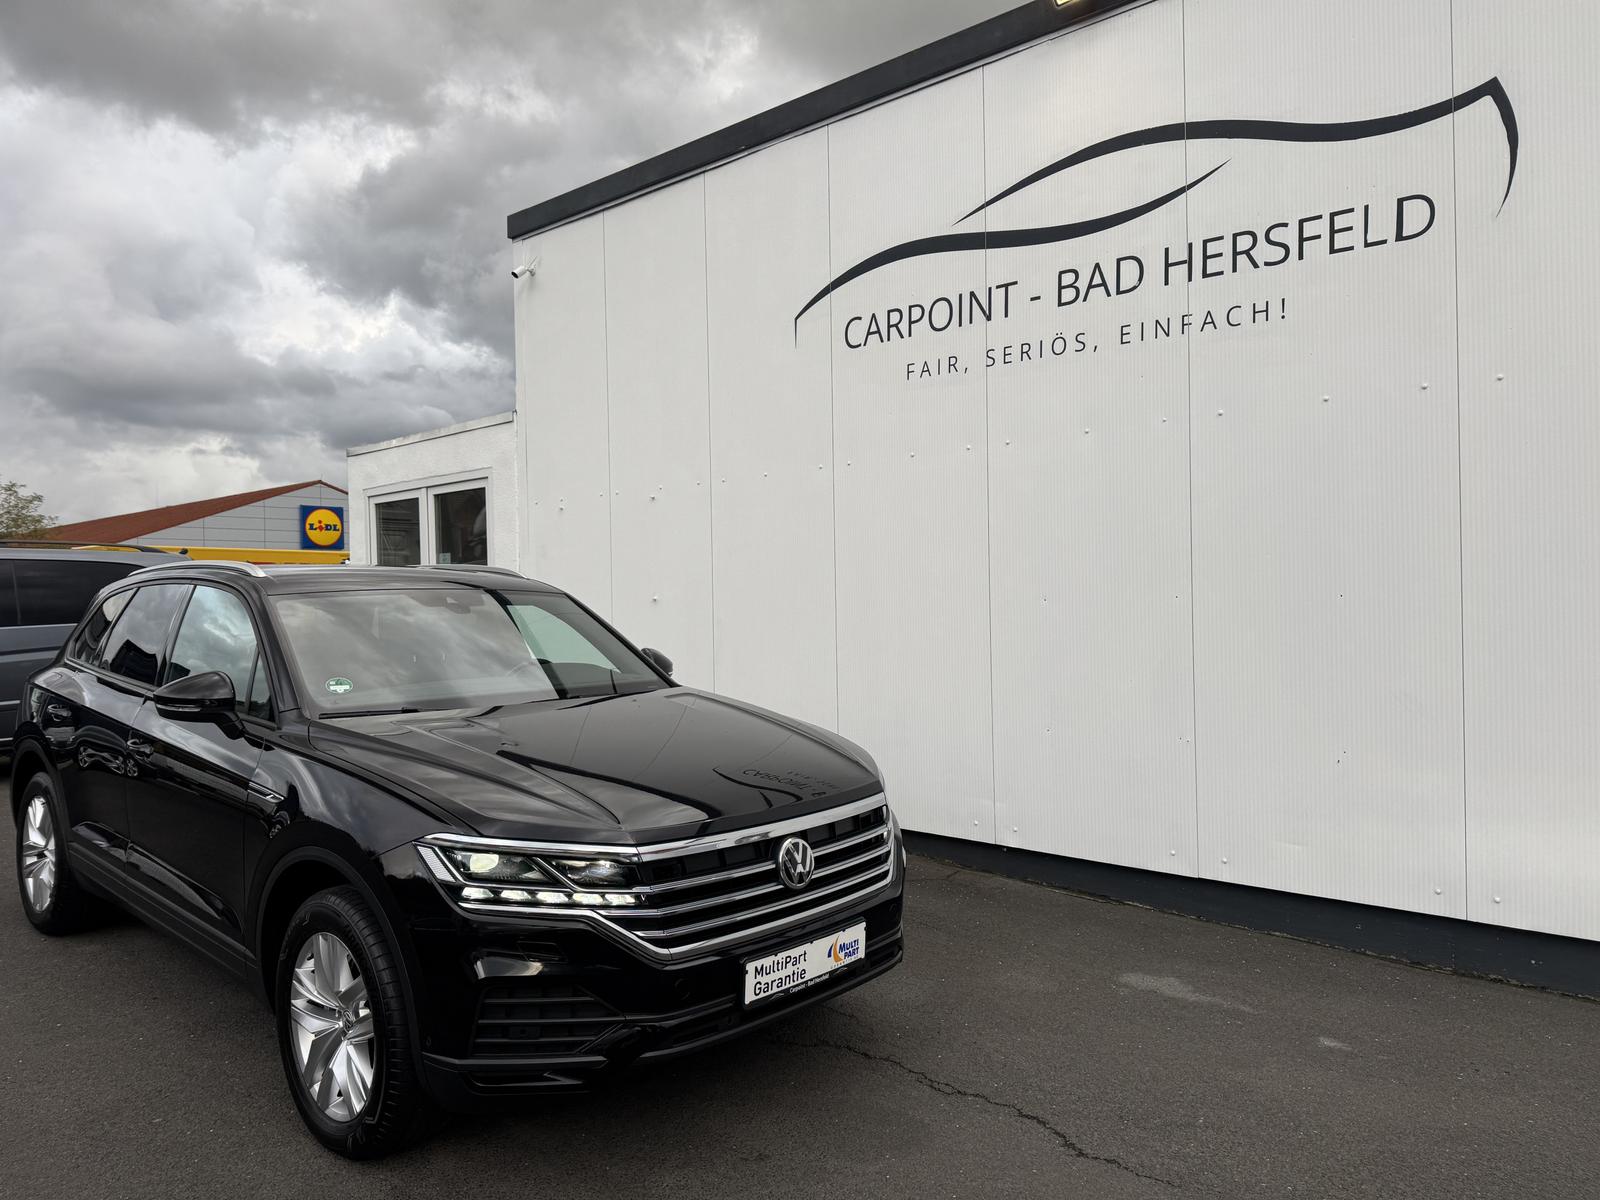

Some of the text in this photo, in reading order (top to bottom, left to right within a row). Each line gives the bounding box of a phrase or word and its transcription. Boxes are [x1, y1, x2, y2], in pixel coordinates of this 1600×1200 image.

[843, 193, 1436, 350] CARPOINT - BAD HERSFELD
[906, 297, 1286, 381] FAIR, SERIÖS, EINFACH!
[839, 939, 859, 954] MULTI
[844, 947, 859, 959] PART
[754, 950, 807, 979] MultiPart
[754, 967, 806, 996] Garantie
